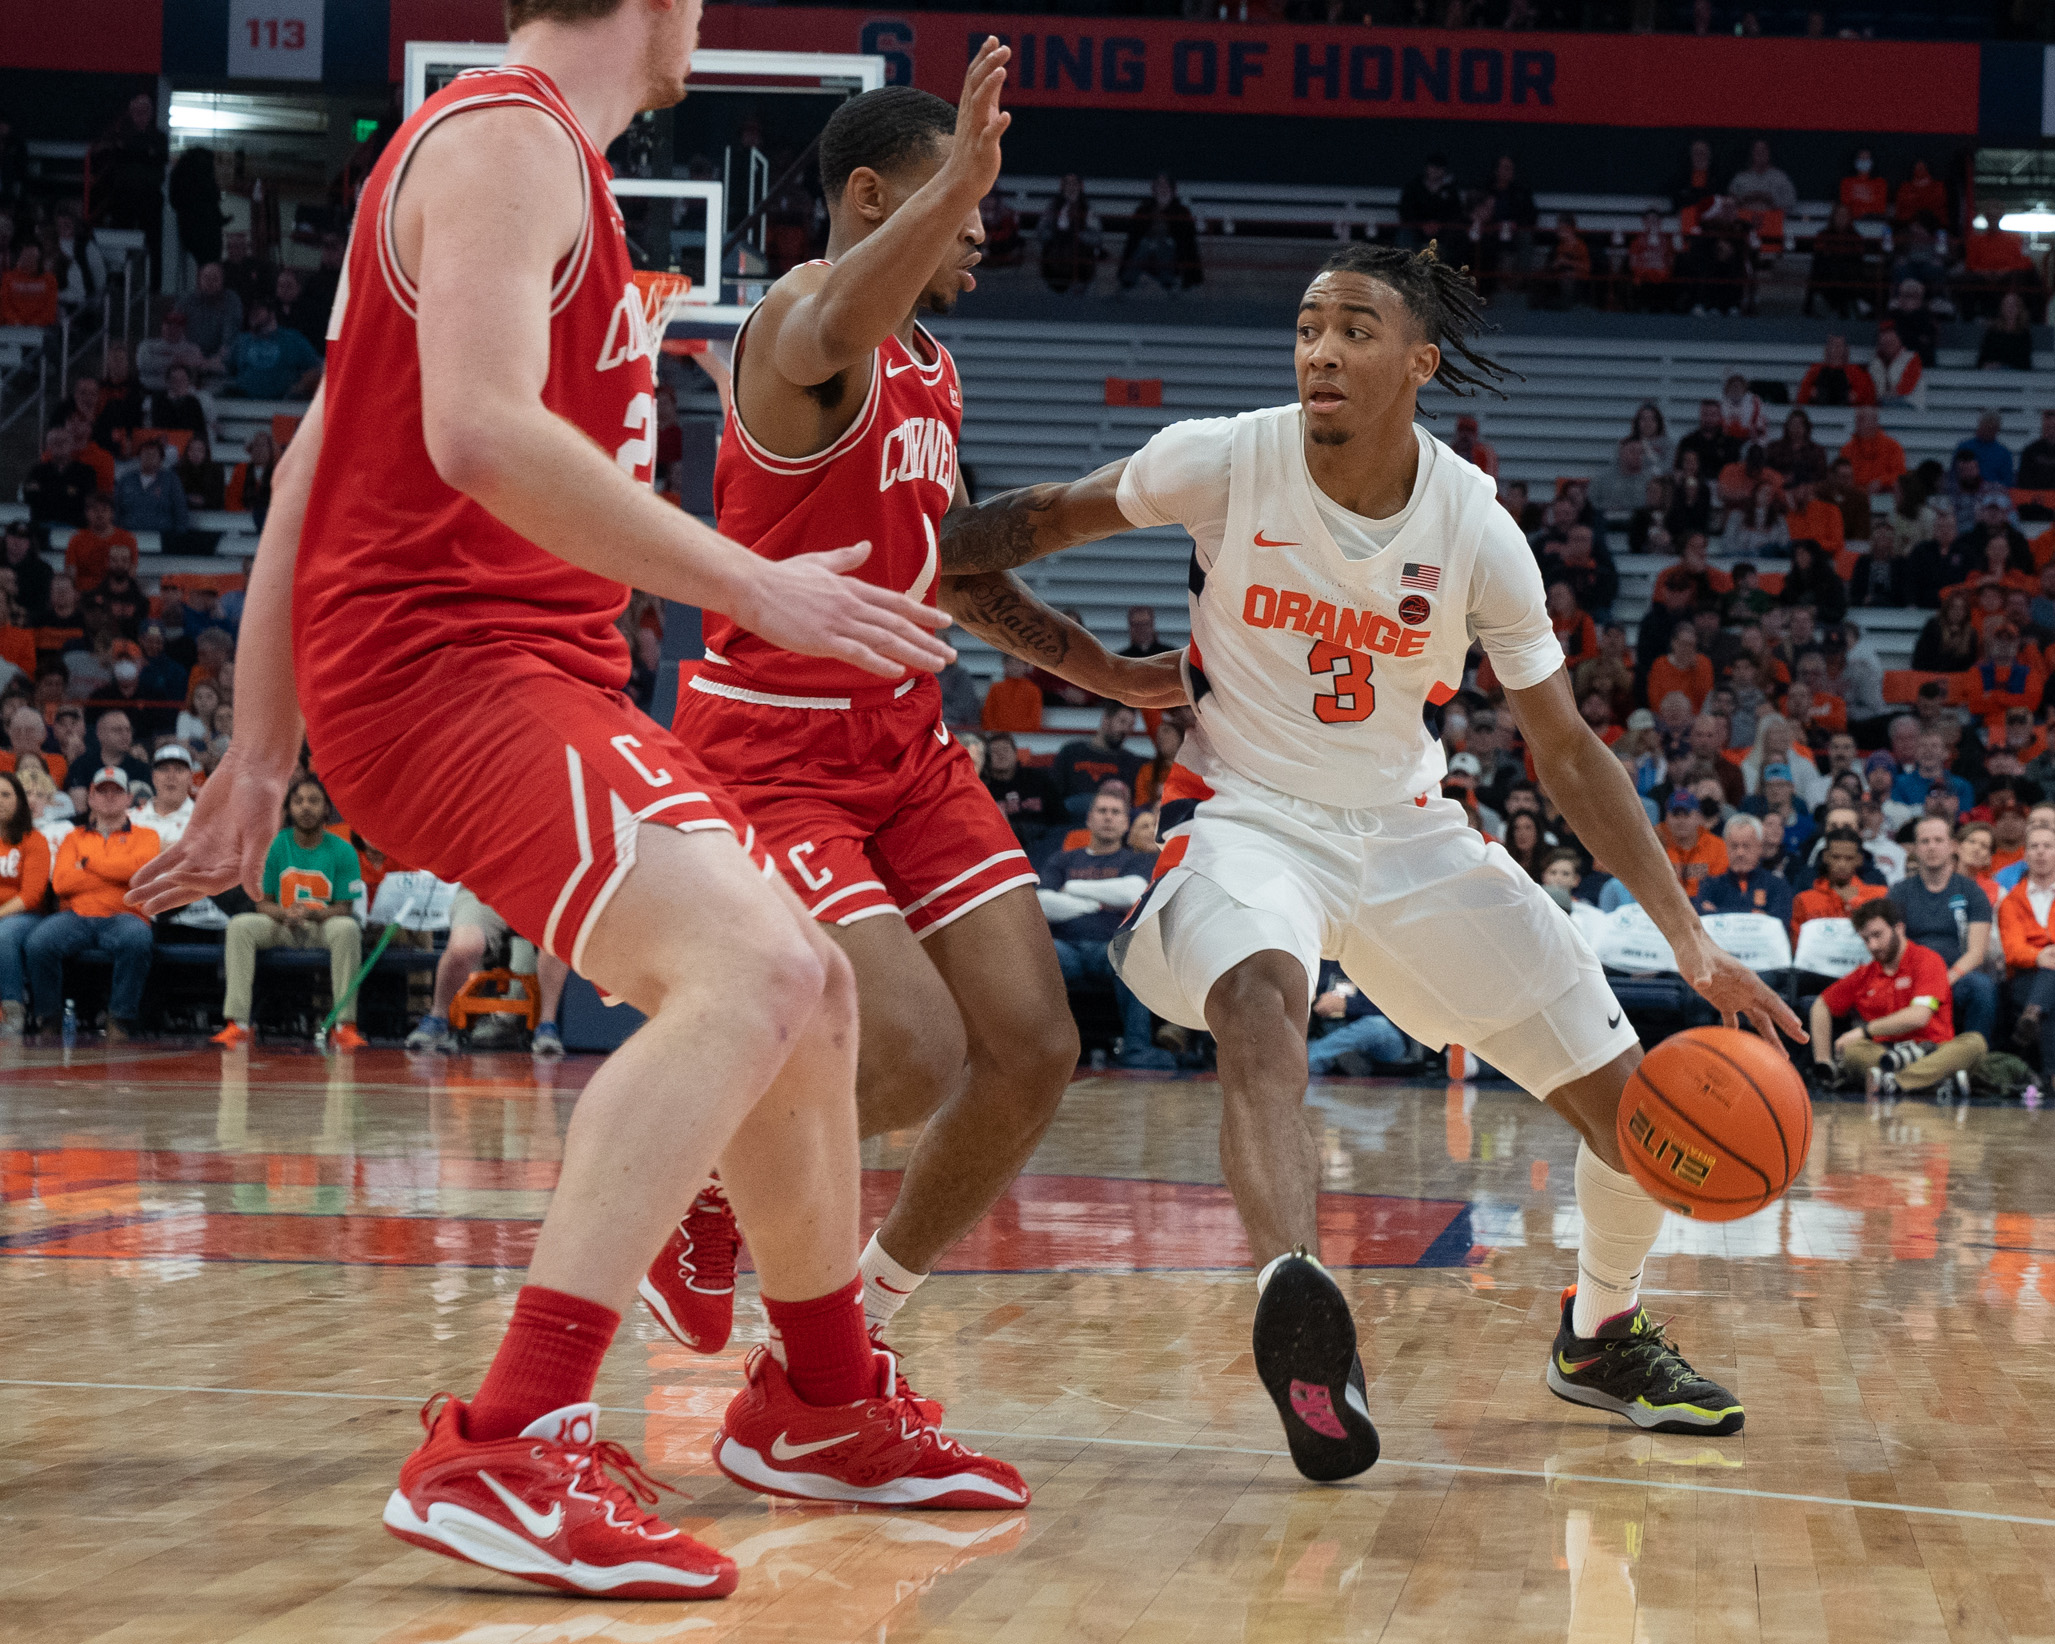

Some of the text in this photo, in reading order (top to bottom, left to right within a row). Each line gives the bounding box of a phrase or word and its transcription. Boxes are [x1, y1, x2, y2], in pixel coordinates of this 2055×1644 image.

[246, 18, 305, 49] 113
[1172, 39, 1269, 97] OF
[1293, 43, 1556, 105] HONOR
[1242, 583, 1432, 658] ORANGE
[1307, 639, 1375, 724] 3
[610, 733, 673, 788] C
[788, 840, 833, 892] C
[1628, 1106, 1713, 1189] ELITE
